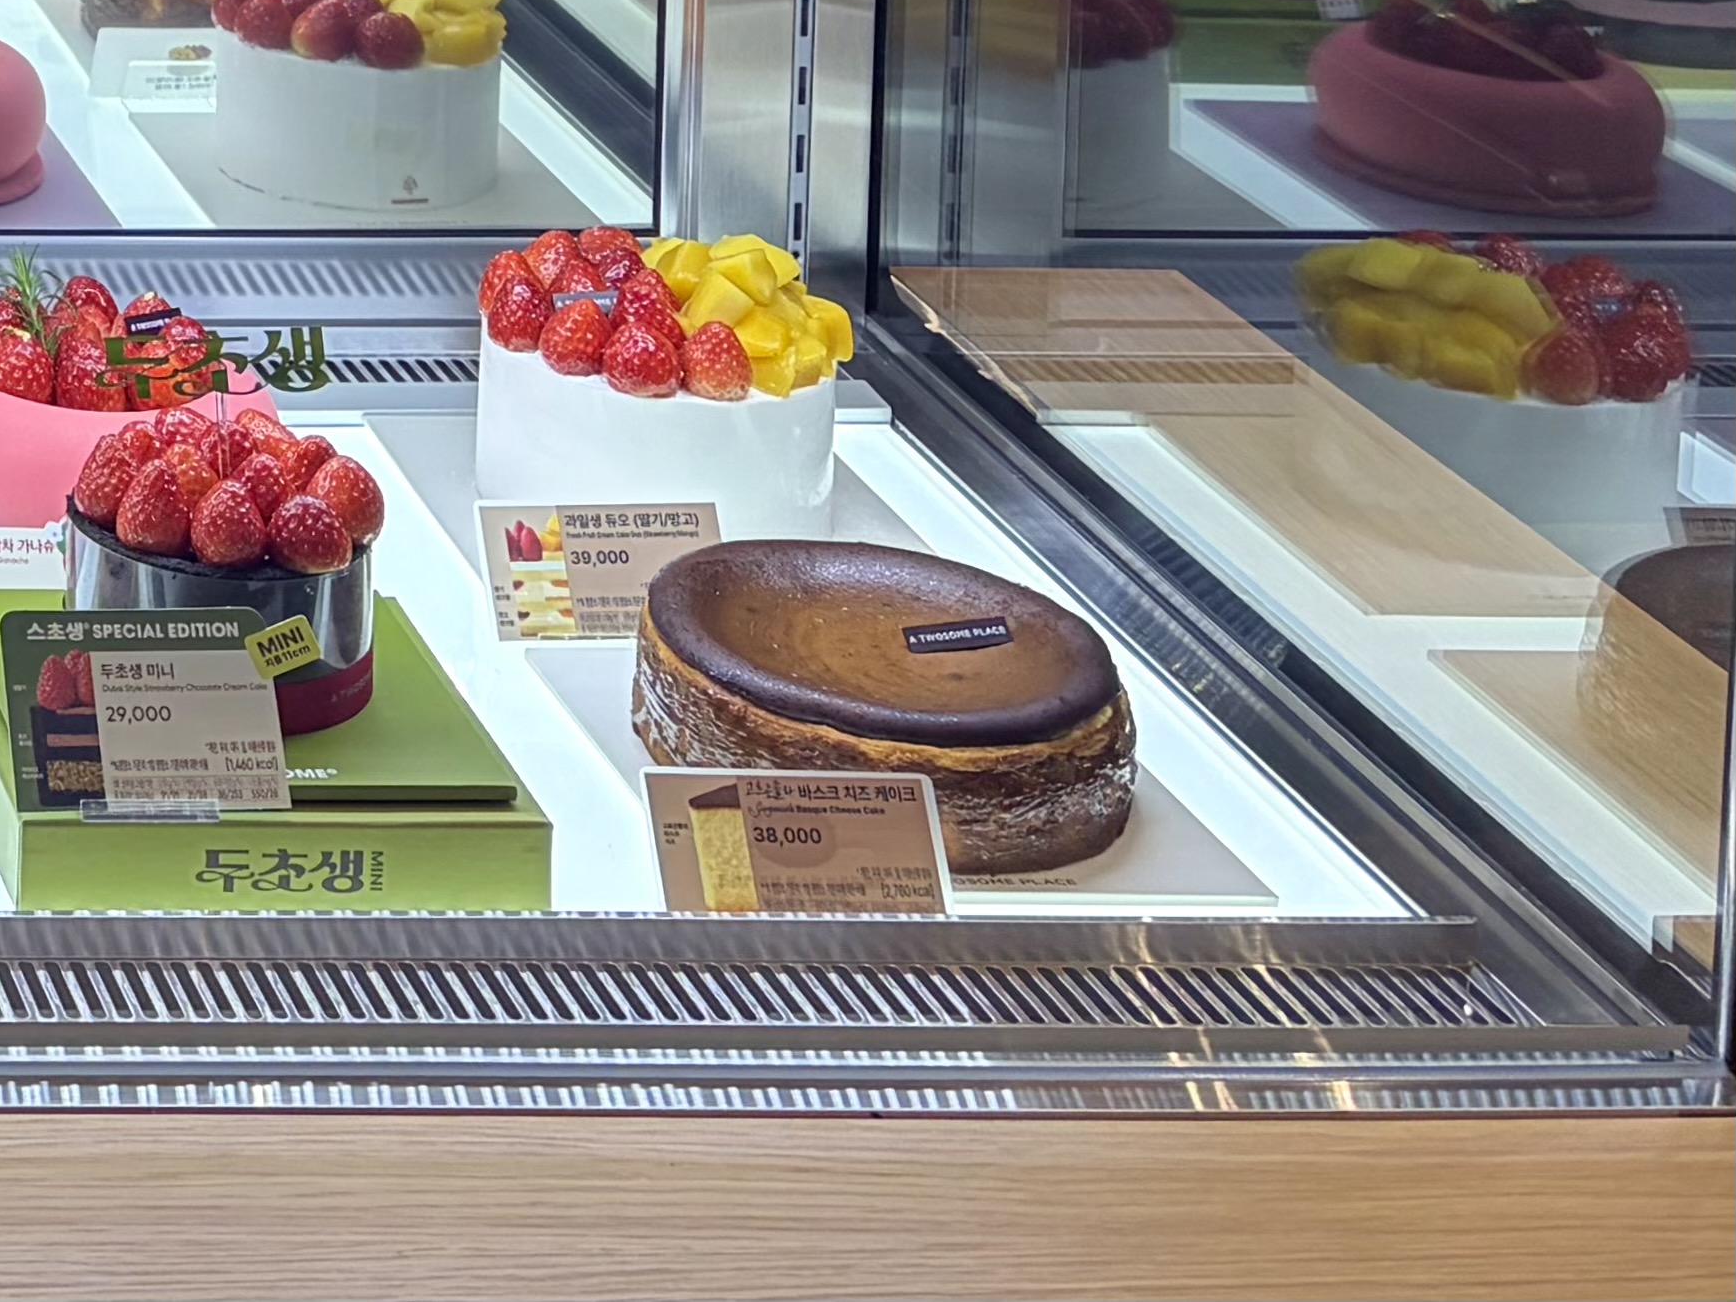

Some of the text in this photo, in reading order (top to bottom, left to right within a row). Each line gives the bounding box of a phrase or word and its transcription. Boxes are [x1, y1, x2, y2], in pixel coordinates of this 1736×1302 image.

[563, 512, 700, 529] 과일생 듀오 (딸기/망고)
[17, 538, 55, 554] 가나슈
[570, 549, 630, 568] 39,000
[92, 622, 165, 640] SPECIAL
[168, 621, 240, 639] EDITION
[909, 625, 1007, 645] A TWOSOME PLACE
[256, 625, 306, 658] MINI
[100, 662, 175, 681] 두초생 미니
[105, 705, 172, 725] 29,000
[797, 784, 841, 801] 바스크
[843, 784, 873, 802] 치즈
[874, 785, 917, 803] 케이크
[752, 826, 822, 847] 38,000
[195, 848, 364, 894] 두초생
[370, 850, 384, 891] MINI
